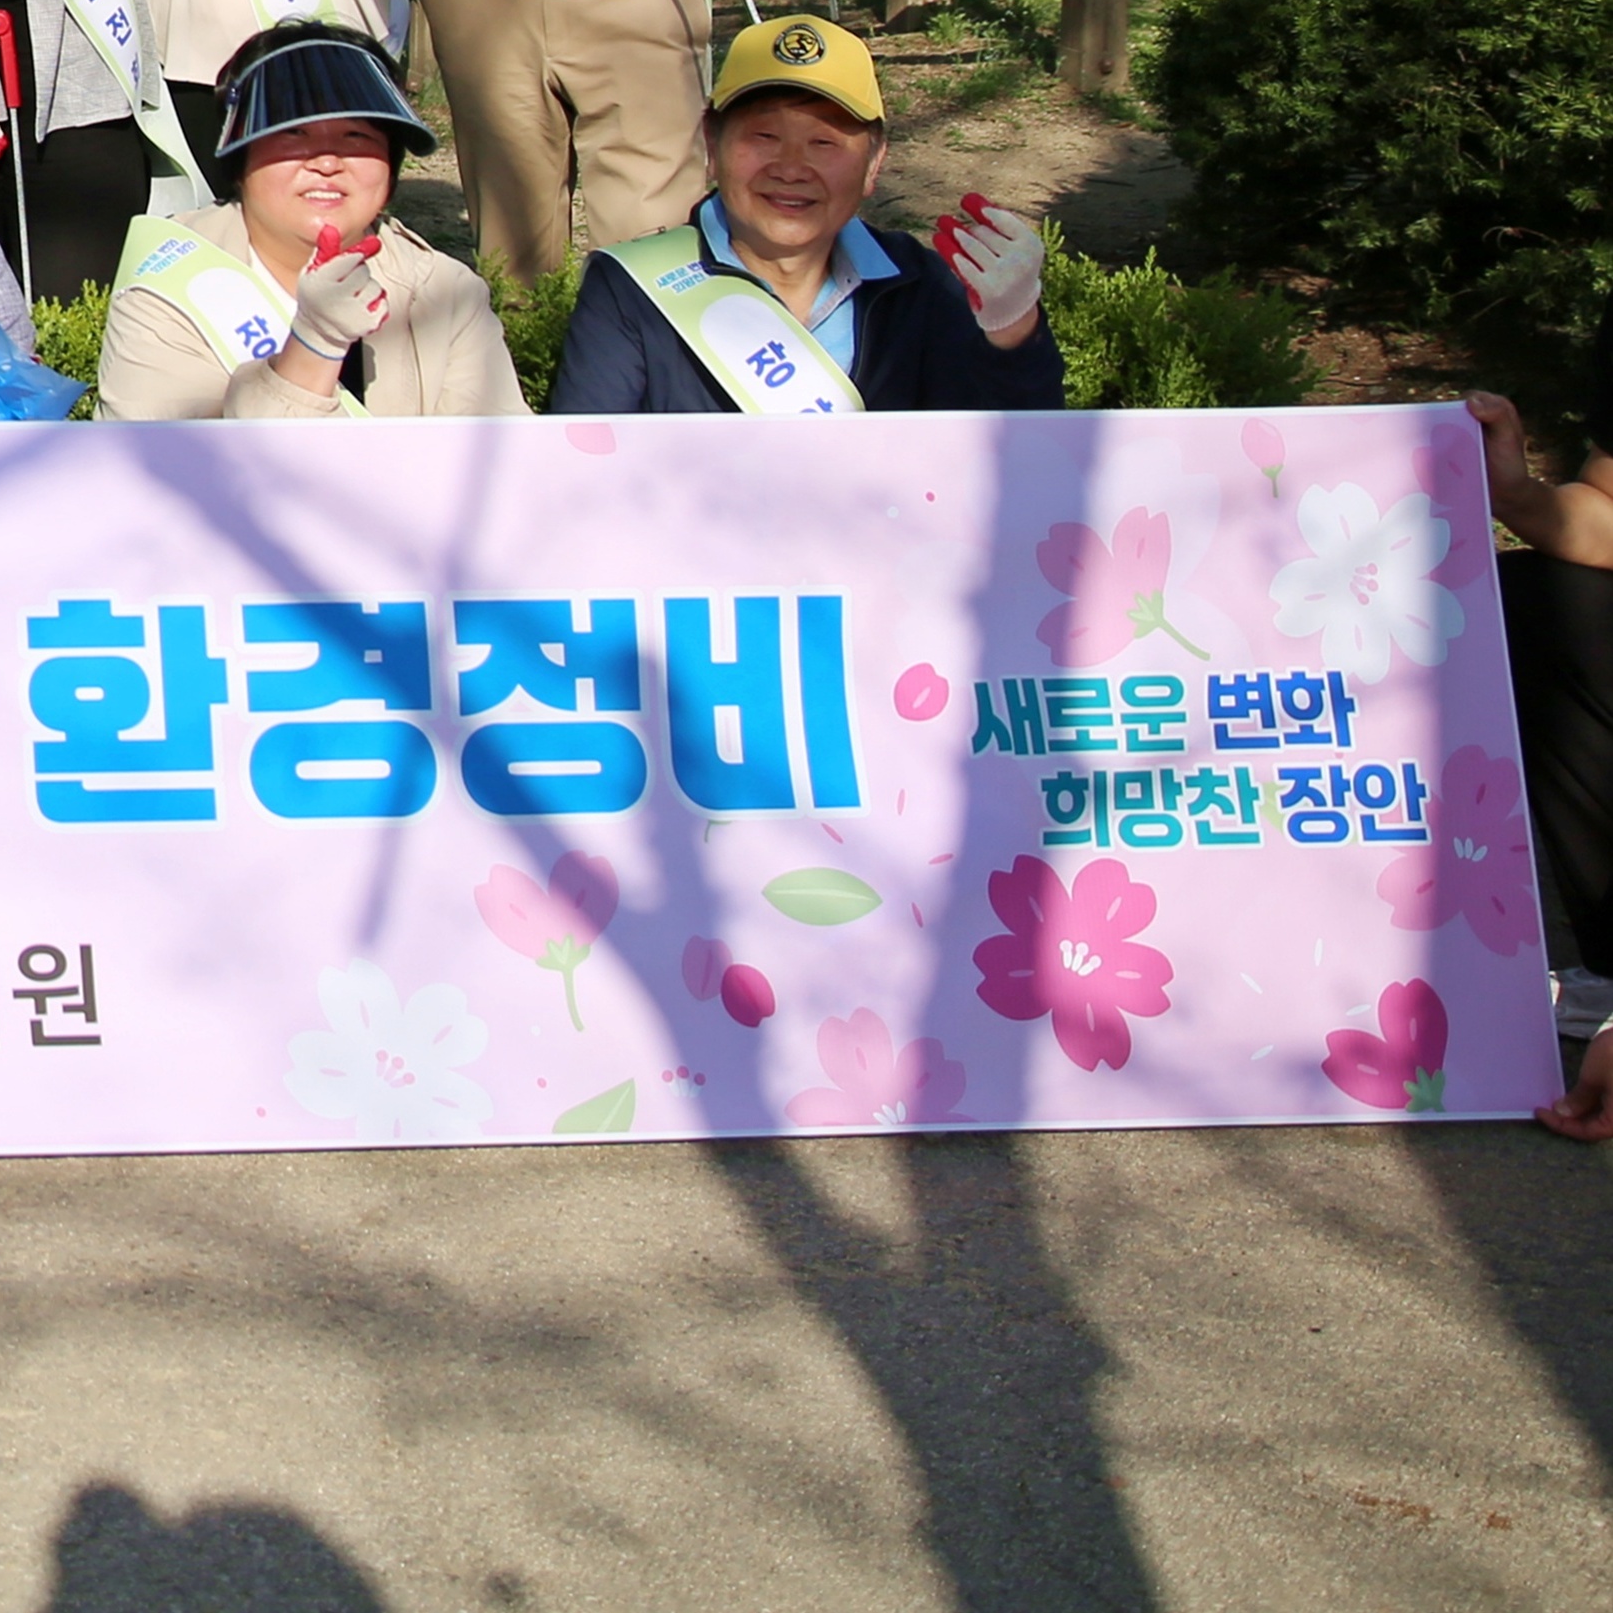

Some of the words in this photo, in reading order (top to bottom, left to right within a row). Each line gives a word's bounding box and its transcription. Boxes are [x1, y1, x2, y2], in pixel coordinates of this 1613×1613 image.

[26, 594, 863, 823] 환경정비
[972, 674, 1188, 756] 새로운
[1205, 669, 1356, 750] 변화
[1040, 769, 1260, 848] 희망찬
[1276, 761, 1430, 845] 장안
